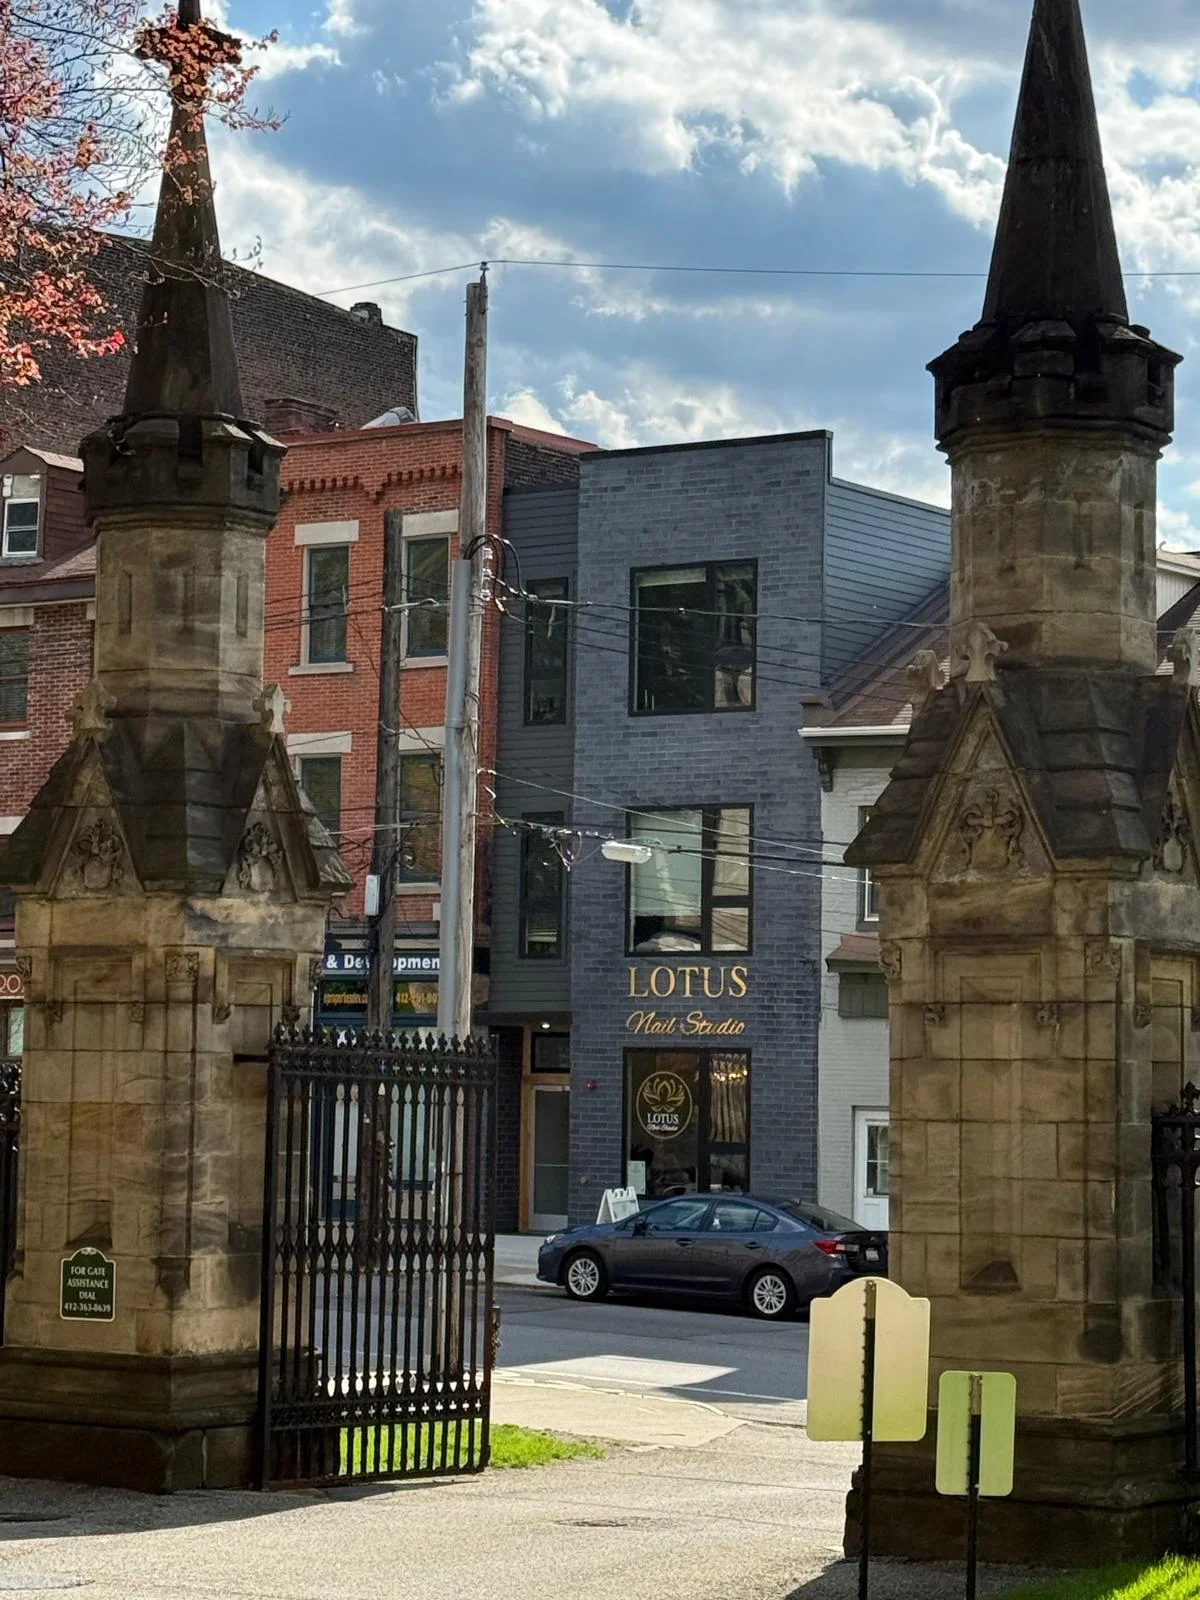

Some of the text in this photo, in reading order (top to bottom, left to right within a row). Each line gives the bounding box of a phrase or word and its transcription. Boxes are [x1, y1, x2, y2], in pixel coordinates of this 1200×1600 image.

[326, 954, 440, 972] & Depmen
[628, 966, 748, 998] LOTUS
[626, 1011, 746, 1036] Nail Studio
[647, 1112, 679, 1124] LOTUS
[71, 1266, 106, 1276] FOR GATE
[66, 1278, 109, 1289] ASSISTANCE
[79, 1291, 96, 1300] DIAL
